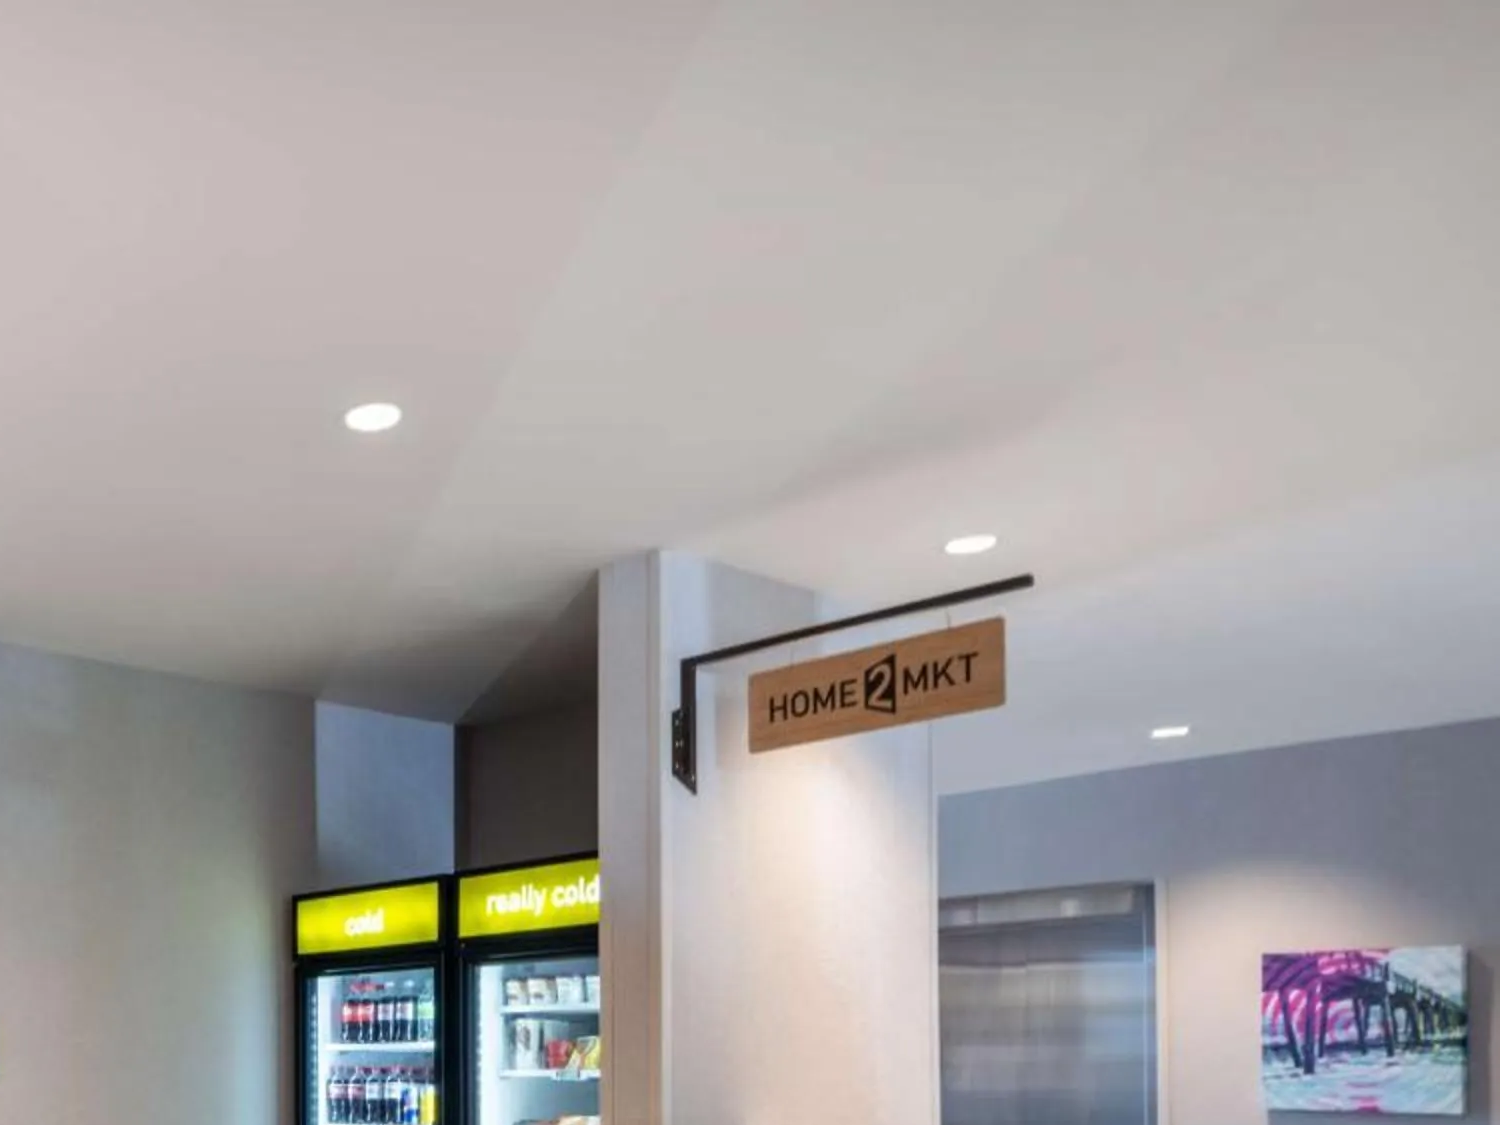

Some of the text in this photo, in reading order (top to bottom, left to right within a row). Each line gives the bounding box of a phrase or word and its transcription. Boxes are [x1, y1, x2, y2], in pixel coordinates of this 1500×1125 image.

[768, 678, 858, 724] HOME
[902, 652, 979, 696] MKT
[485, 874, 600, 917] really cold
[344, 908, 385, 936] cold
